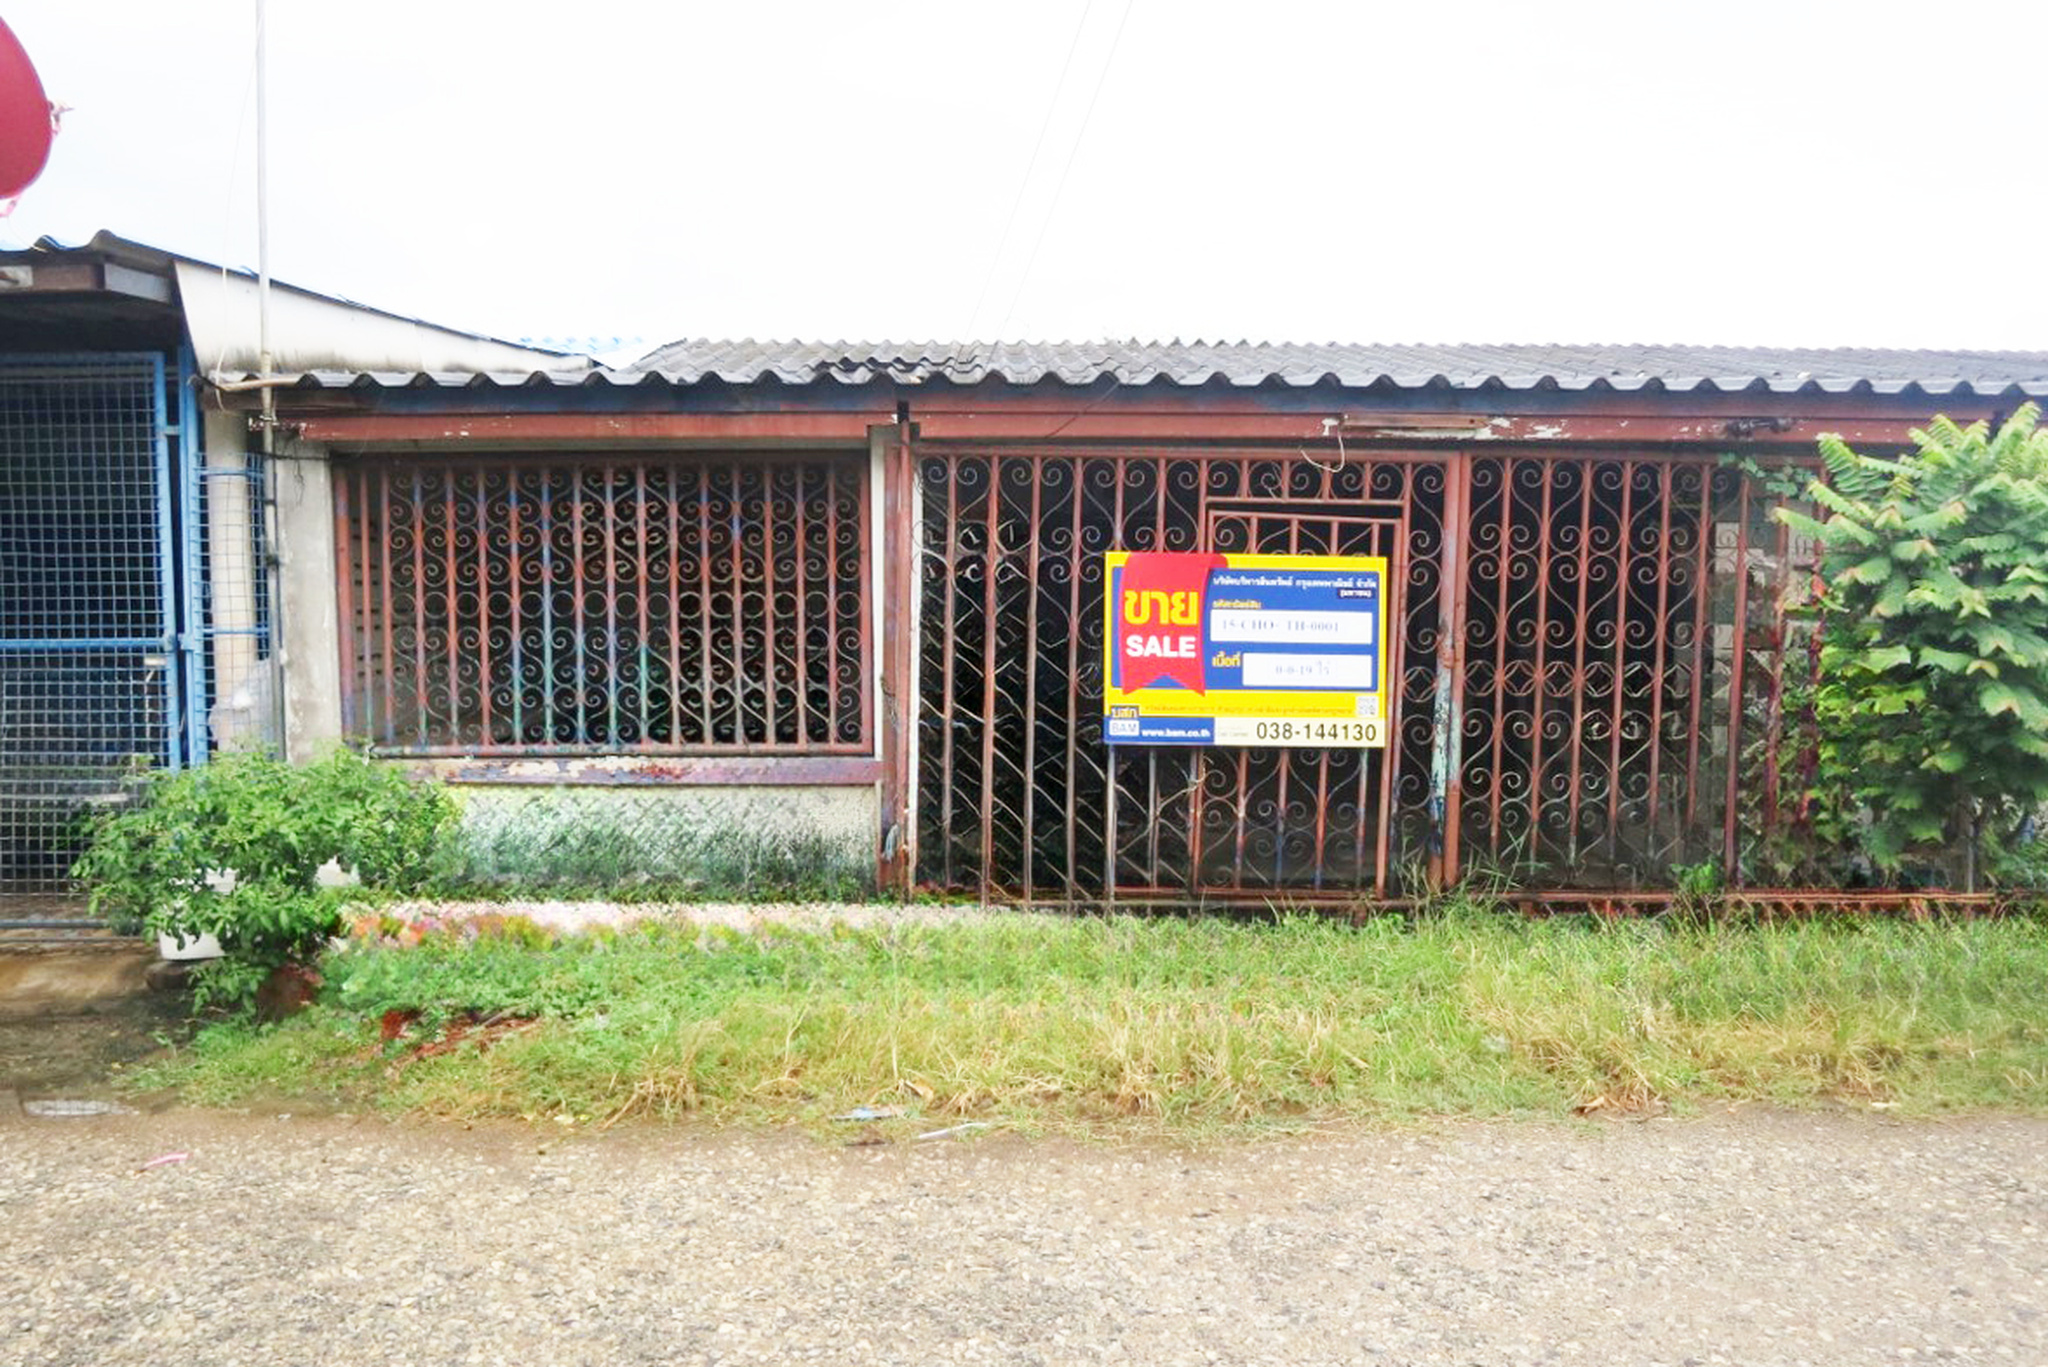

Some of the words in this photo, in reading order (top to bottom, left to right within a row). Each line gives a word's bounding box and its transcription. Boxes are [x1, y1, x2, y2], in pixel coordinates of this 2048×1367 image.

[1124, 589, 1199, 626] ขาย
[1126, 635, 1196, 658] SALE
[1112, 721, 1137, 733] BAM
[1141, 728, 1210, 738] www.bam.co.th
[1256, 722, 1377, 742] 038-144130
